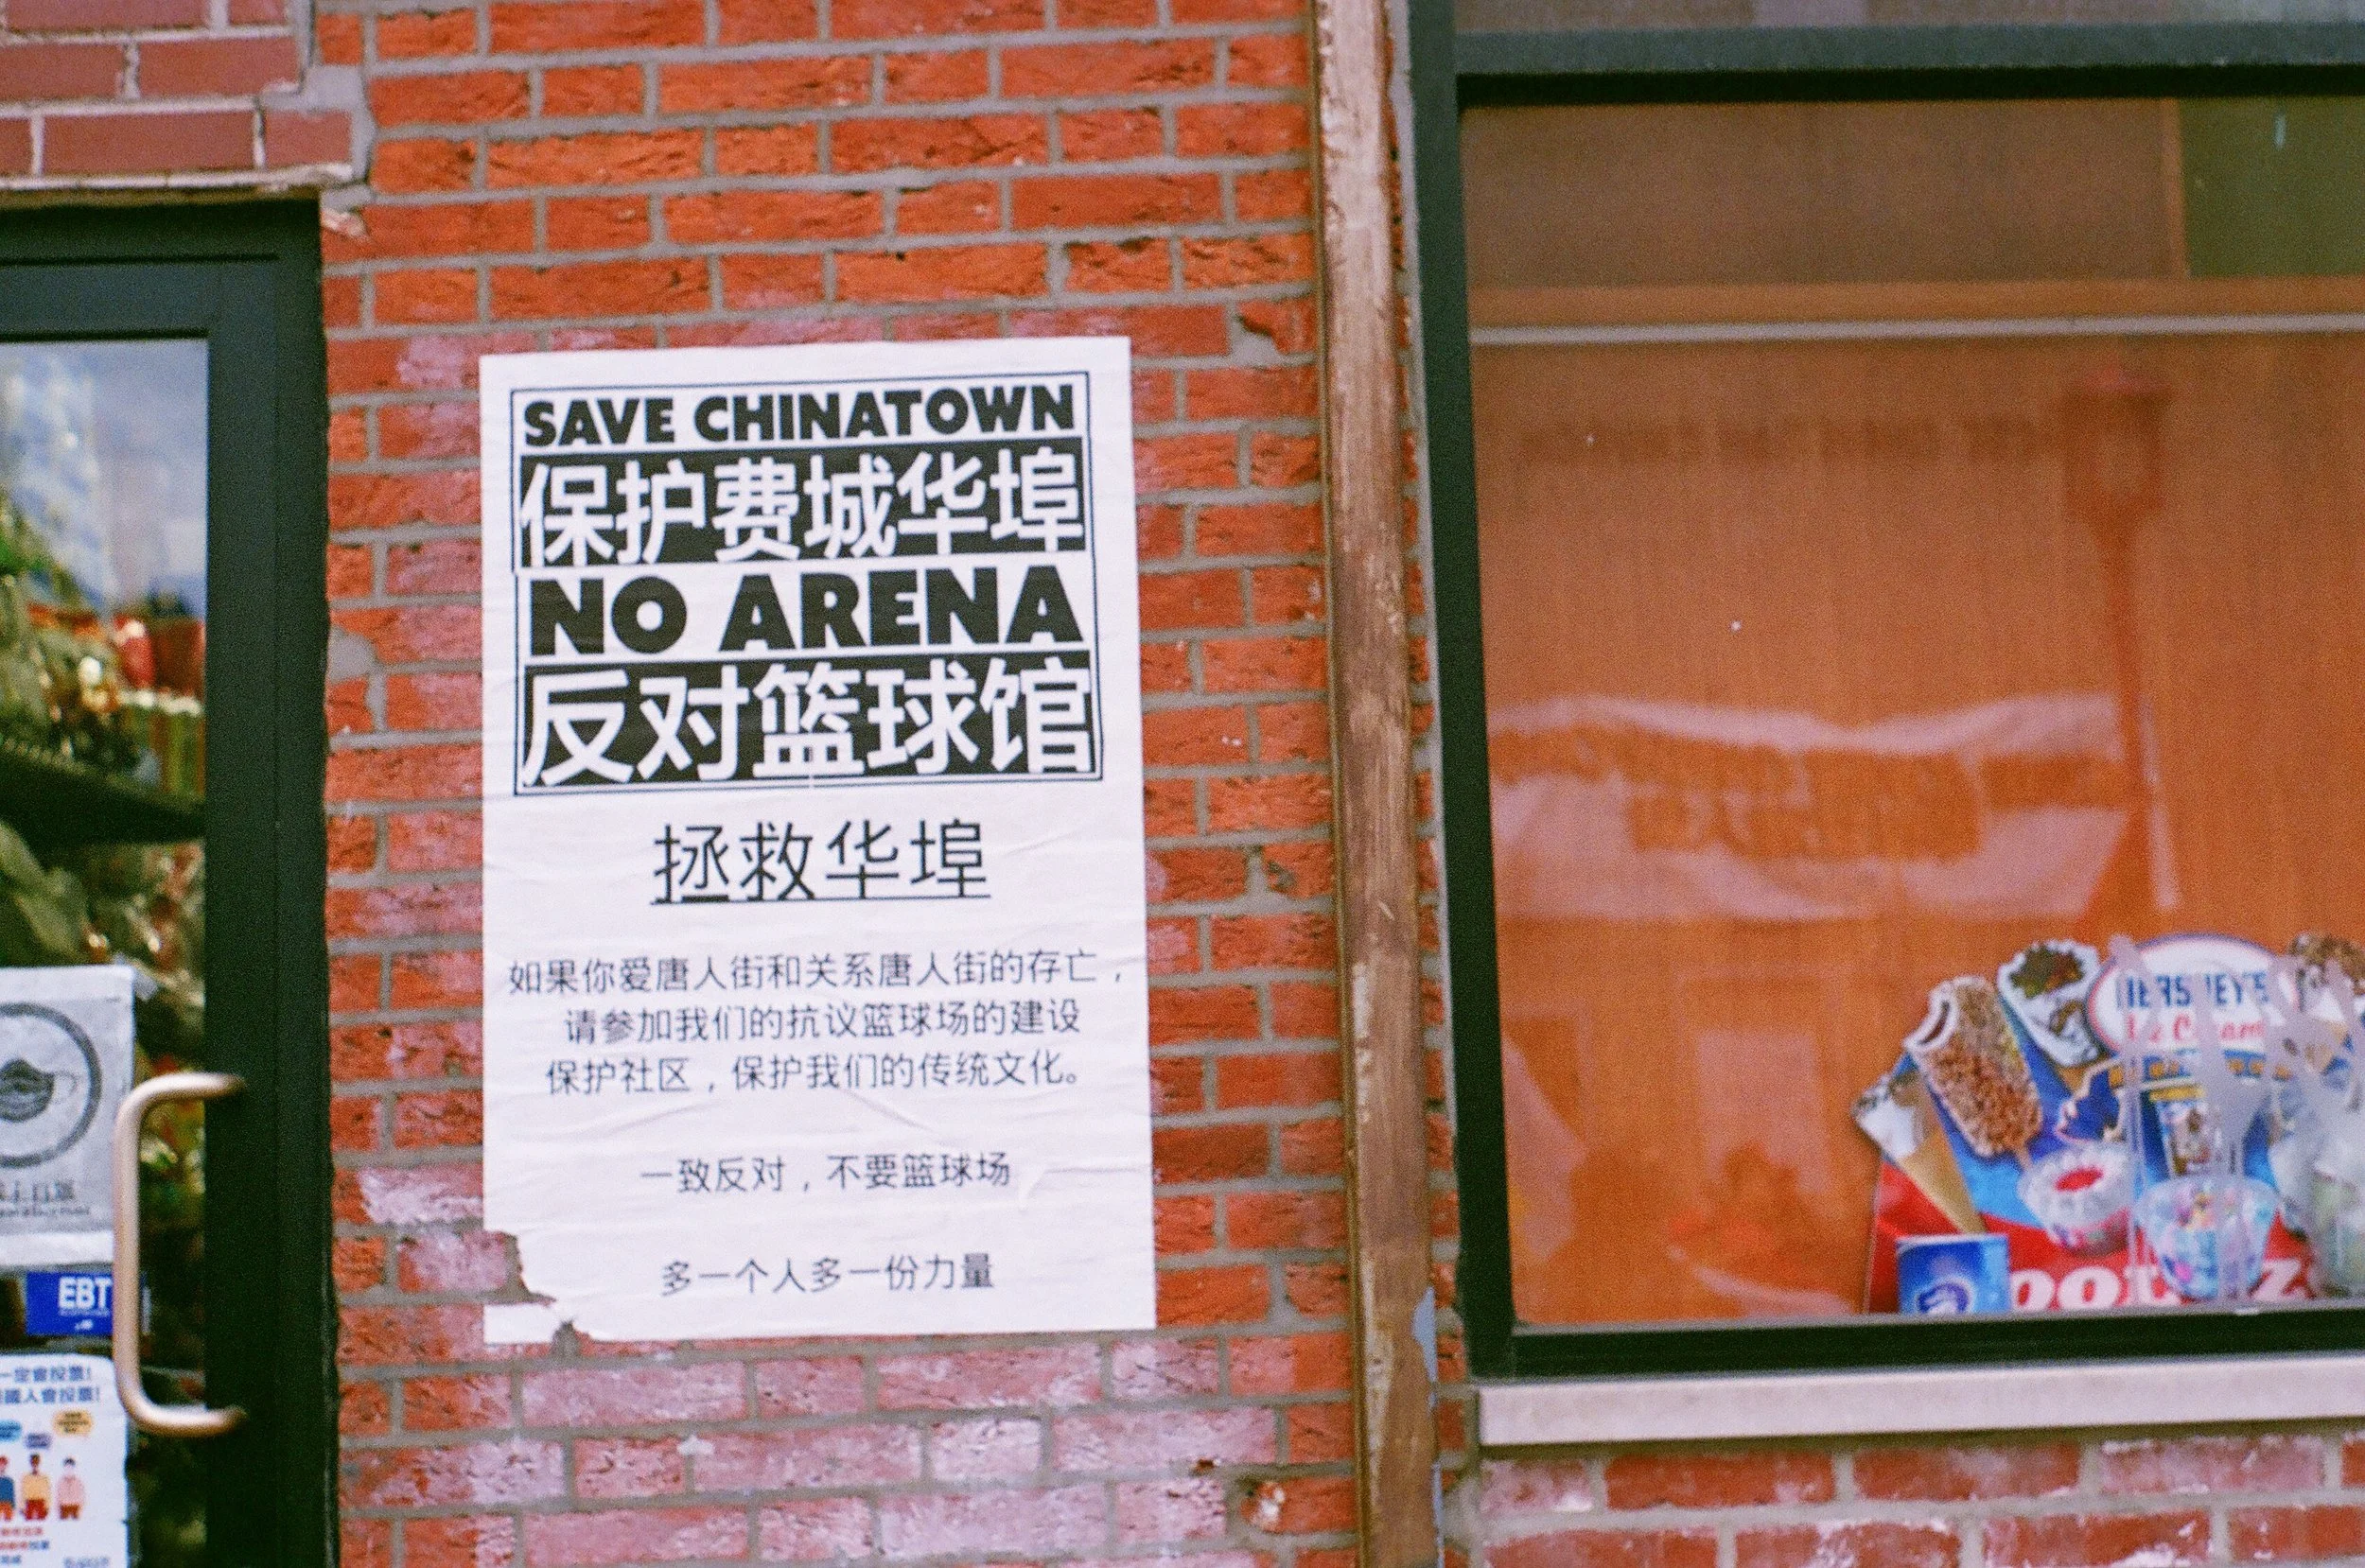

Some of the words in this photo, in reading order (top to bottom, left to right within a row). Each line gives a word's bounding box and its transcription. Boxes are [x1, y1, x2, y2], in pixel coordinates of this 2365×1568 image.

[523, 396, 675, 447] SAVE
[693, 383, 1076, 444] CHINATOWN
[519, 446, 1083, 567] 保护费城华埠
[530, 575, 688, 656] NO
[719, 566, 1084, 653] ARENA
[519, 656, 1094, 787] 反对篮球馆
[653, 817, 989, 900] 拯救华埠
[565, 997, 1080, 1044] 请参加我们的抗议篮球场的建设
[640, 1151, 1011, 1193] 一致反对,不要篮球场
[59, 1276, 113, 1310] EBT
[661, 1252, 995, 1297] 多一个人多一份力量
